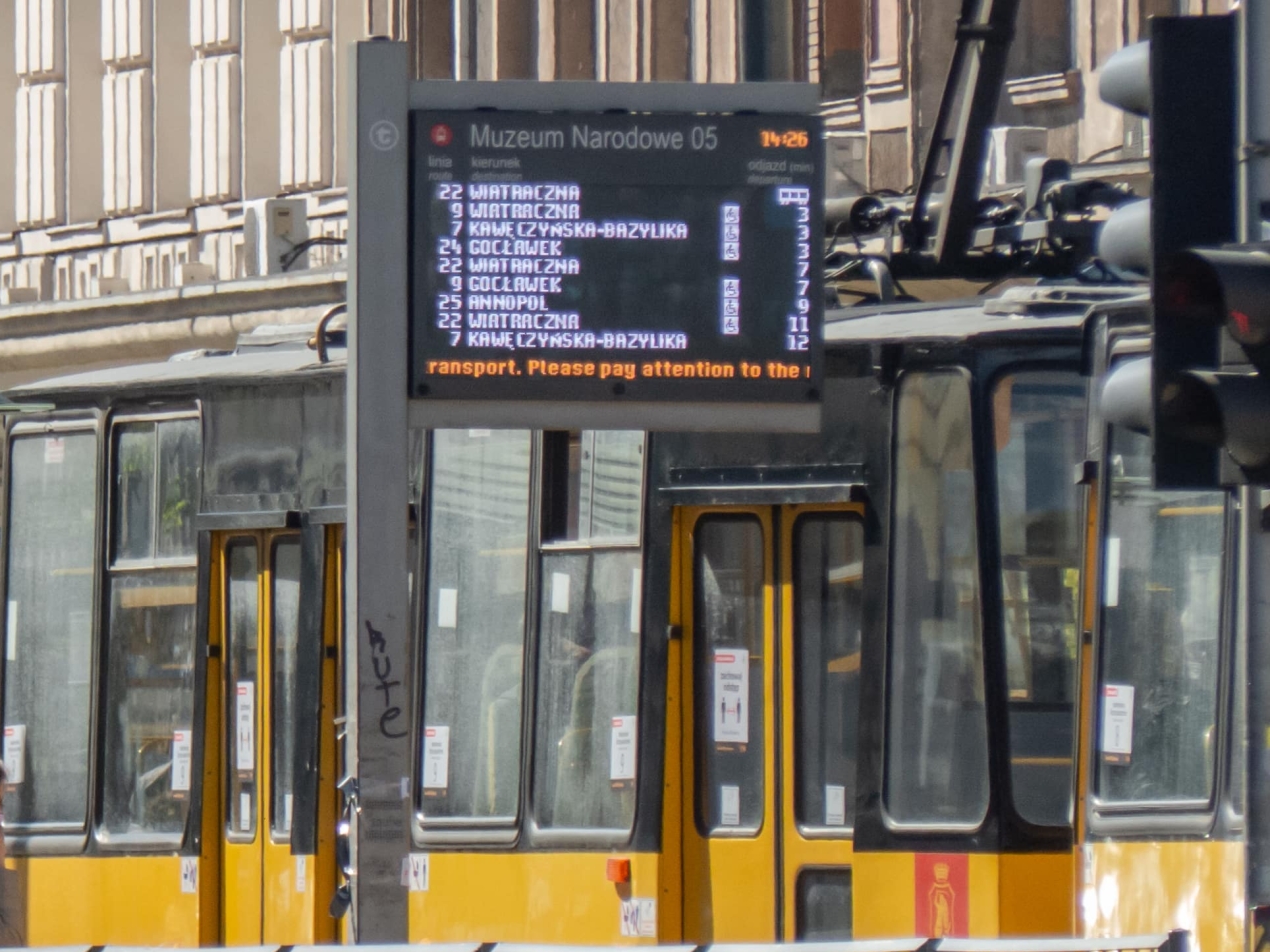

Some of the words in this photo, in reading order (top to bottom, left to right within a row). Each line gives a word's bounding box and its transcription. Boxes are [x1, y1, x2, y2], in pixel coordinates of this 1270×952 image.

[470, 124, 564, 148] Muzeum
[571, 125, 684, 150] Narodowe
[691, 126, 718, 150] 05
[760, 130, 809, 148] 14:26
[471, 156, 520, 168] kierunek
[439, 184, 463, 200] 22
[469, 184, 580, 200] WIATRACZNA
[451, 203, 463, 219] 9
[469, 203, 580, 219] WIATRACZNA
[798, 206, 809, 222] 3
[451, 222, 463, 237] 7
[798, 225, 809, 240] 3
[439, 239, 463, 256] 24
[469, 240, 562, 256] GOCŁAWEK
[798, 243, 809, 259] 3
[439, 258, 463, 273] 22
[469, 258, 580, 274] WIATRACZNA
[798, 262, 809, 277] 7
[451, 276, 463, 292] 9
[468, 276, 562, 293] GOCŁAWEK
[798, 280, 809, 296] 7
[439, 295, 462, 310] 25
[468, 295, 549, 311] ANNOPOL
[798, 299, 809, 314] 9
[438, 313, 462, 329] 22
[468, 313, 580, 330] WIATRACZNA
[789, 317, 809, 332] 11
[450, 332, 461, 347] 7
[788, 335, 809, 350] 12
[528, 360, 596, 377] Please
[600, 363, 637, 380] pay
[642, 361, 735, 378] attention
[741, 361, 762, 379] to
[767, 361, 801, 379] the
